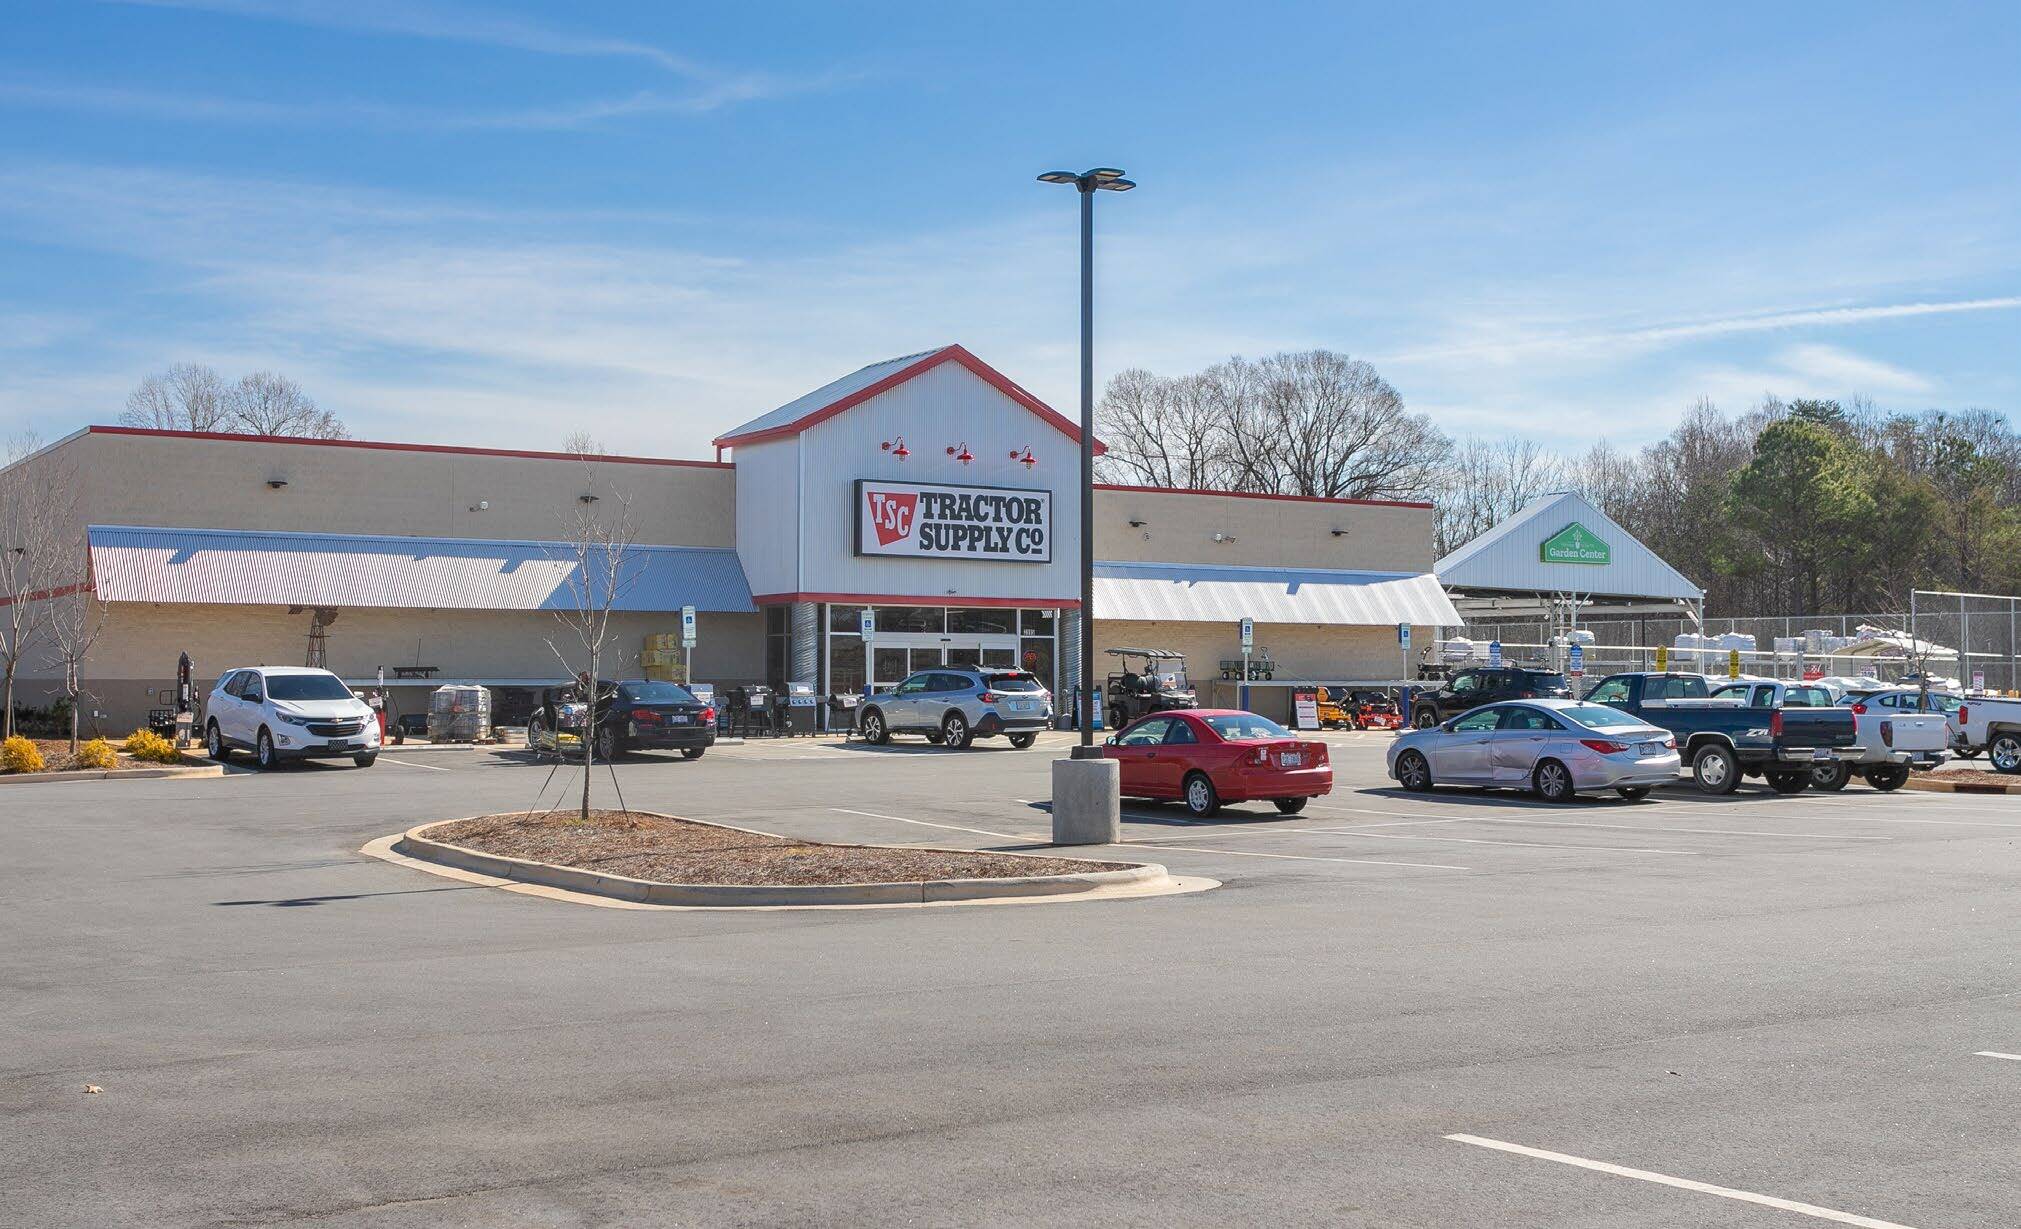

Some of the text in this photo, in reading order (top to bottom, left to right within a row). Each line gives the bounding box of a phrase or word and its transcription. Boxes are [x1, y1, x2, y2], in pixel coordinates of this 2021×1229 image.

[873, 494, 909, 536] TSC
[919, 492, 1043, 525] TRACTOR
[919, 522, 1013, 553] SUPPLY
[1549, 547, 1606, 559] Garden Center
